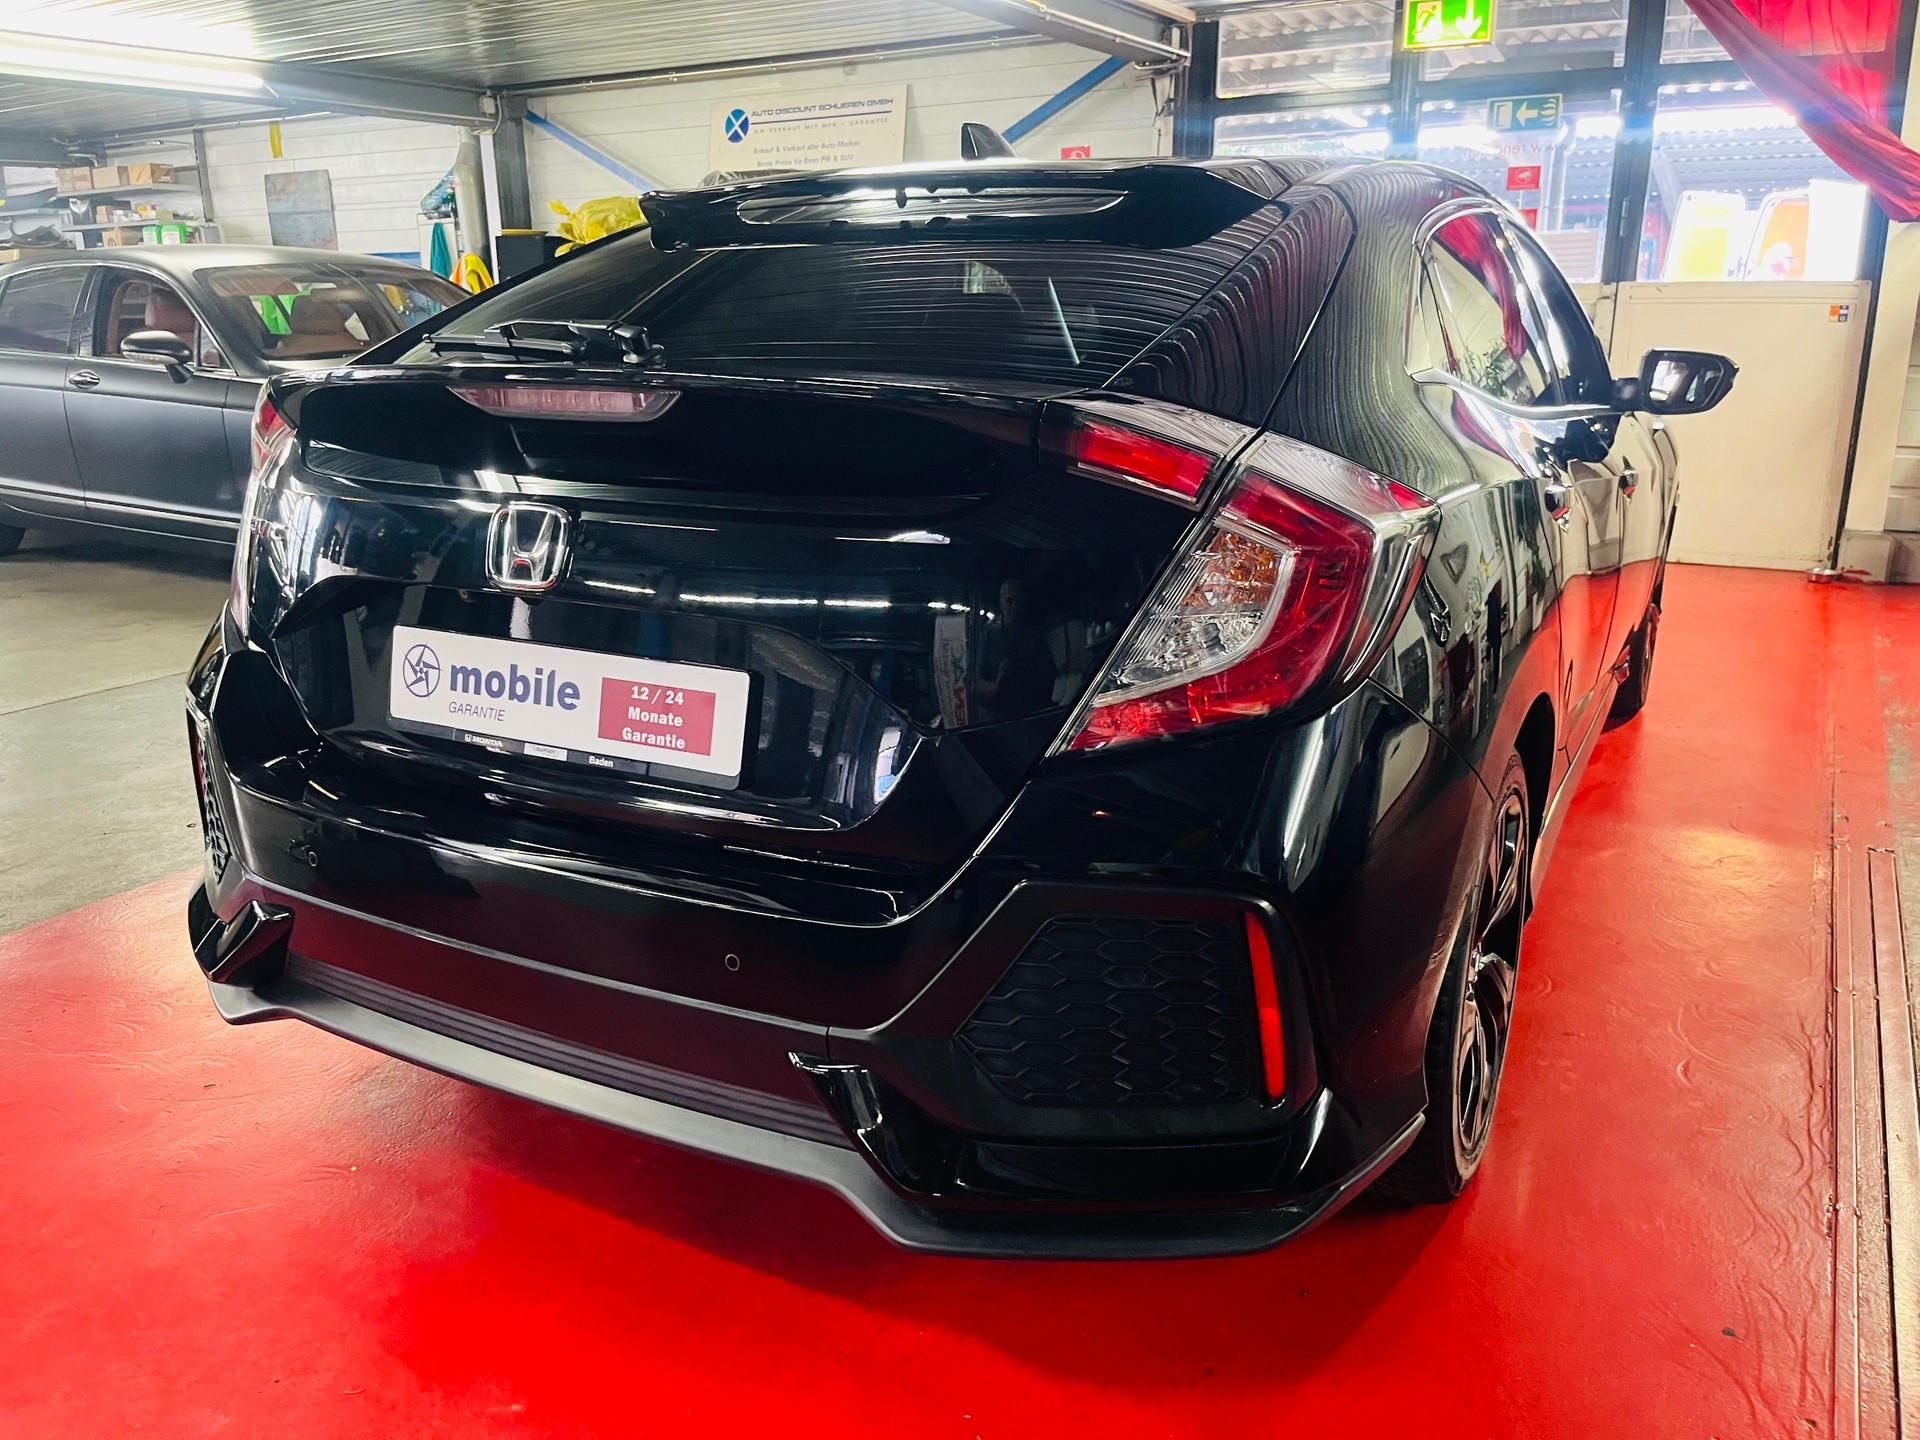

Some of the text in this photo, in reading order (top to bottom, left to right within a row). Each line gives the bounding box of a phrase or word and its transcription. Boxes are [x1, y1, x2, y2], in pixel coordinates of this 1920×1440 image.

[751, 109, 774, 117] AUTO
[775, 105, 817, 115] DISCOUNT
[818, 101, 865, 111] SCHLIEREN
[849, 118, 888, 126] GARANTIE
[450, 664, 581, 711] mobile
[631, 685, 684, 705] 12 / 24
[448, 701, 506, 721] GARANTIE
[628, 706, 683, 727] Monate
[471, 735, 503, 748] HONDA
[622, 727, 686, 749] Garantie
[589, 755, 614, 768] Baden
